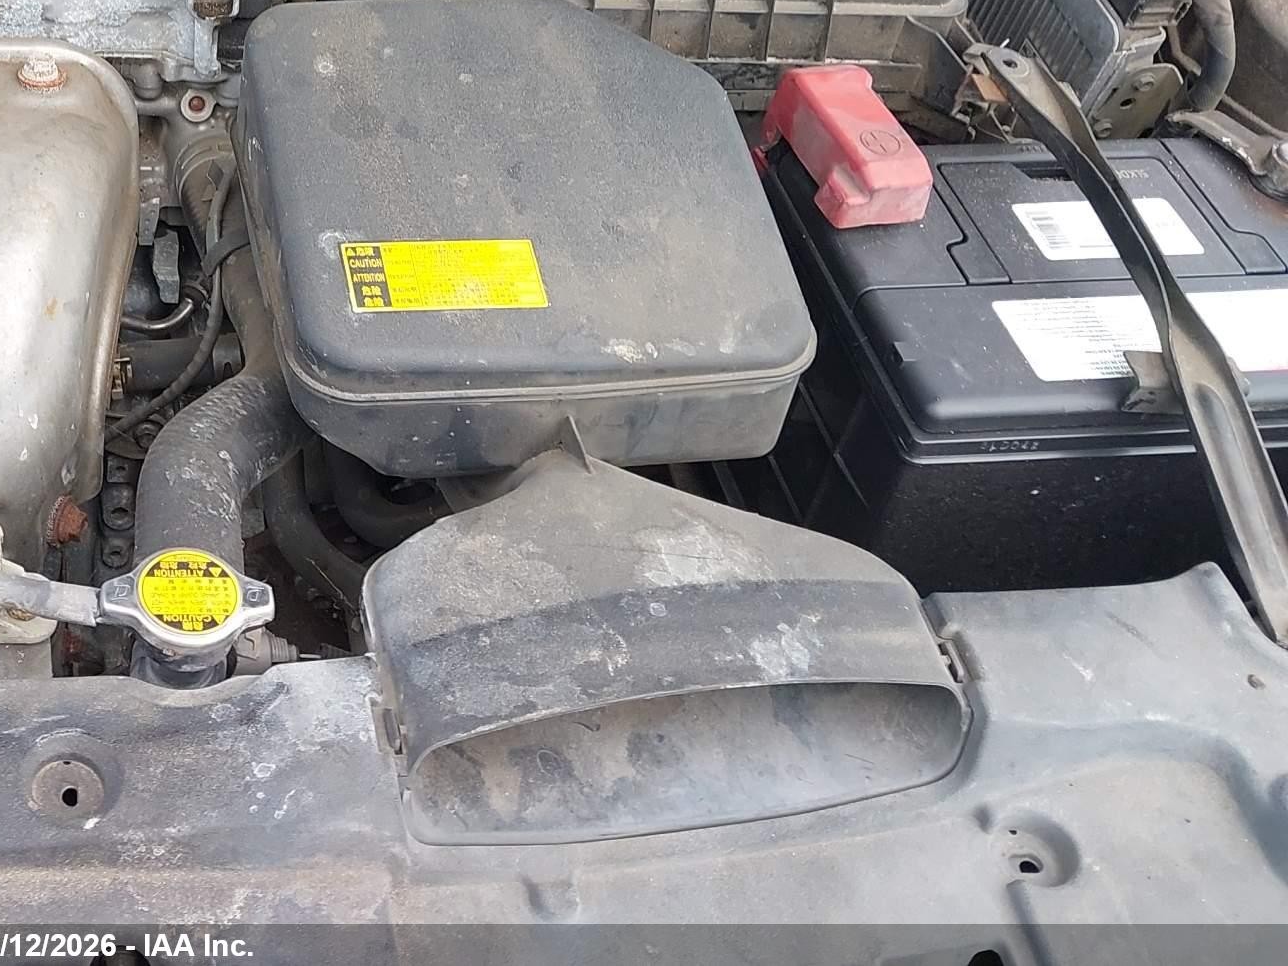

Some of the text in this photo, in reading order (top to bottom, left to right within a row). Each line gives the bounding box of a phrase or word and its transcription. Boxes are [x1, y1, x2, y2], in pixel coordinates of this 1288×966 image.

[349, 258, 383, 268] CAUTION
[352, 273, 386, 283] ATTENTION
[153, 568, 204, 578] ATTENTION
[163, 614, 212, 623] CAUTION
